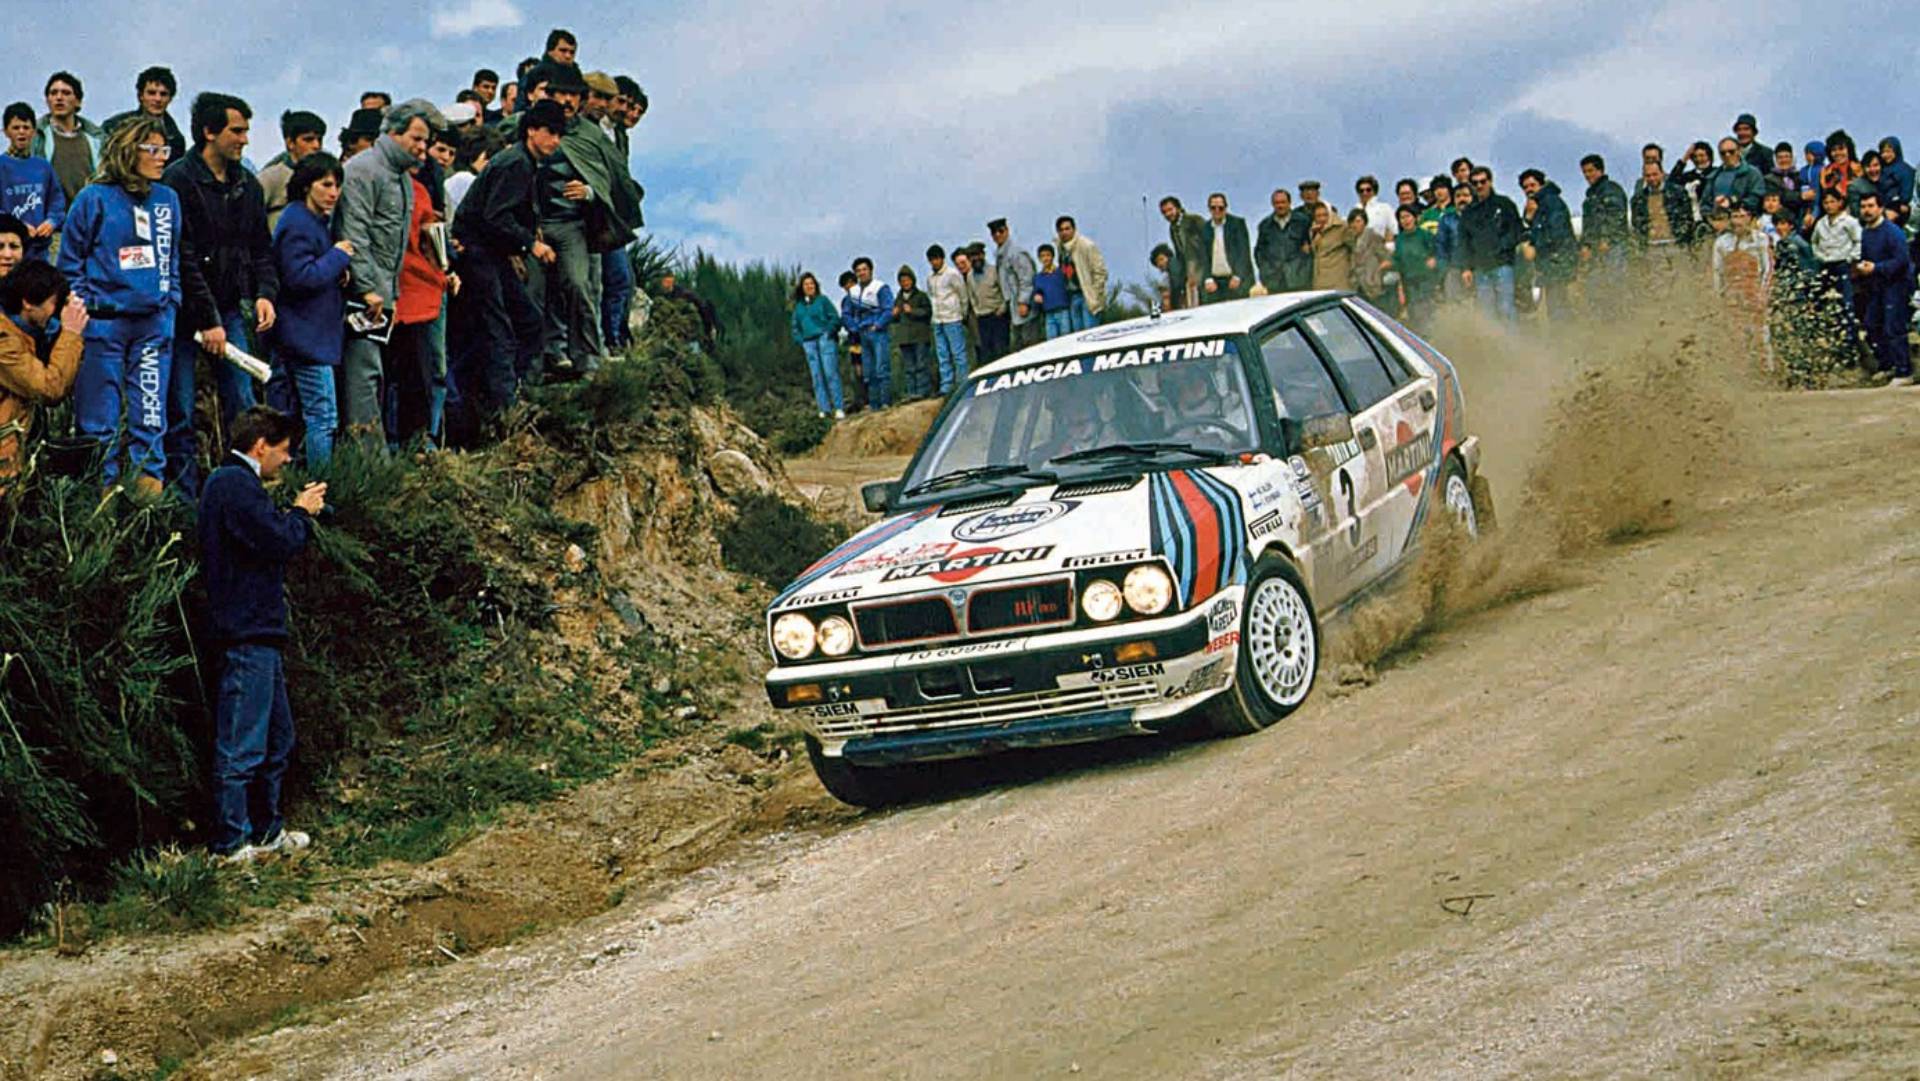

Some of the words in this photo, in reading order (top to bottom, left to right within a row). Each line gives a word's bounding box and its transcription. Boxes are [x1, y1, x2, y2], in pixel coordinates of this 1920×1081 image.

[974, 359, 1083, 396] LANCIA
[1092, 338, 1227, 372] MARTINI
[1248, 508, 1284, 540] PIRELLI
[887, 546, 1053, 580] MARTINI
[1061, 548, 1148, 568] PIRELLI
[1117, 662, 1166, 680] SIEM
[815, 702, 860, 717] SIEM
